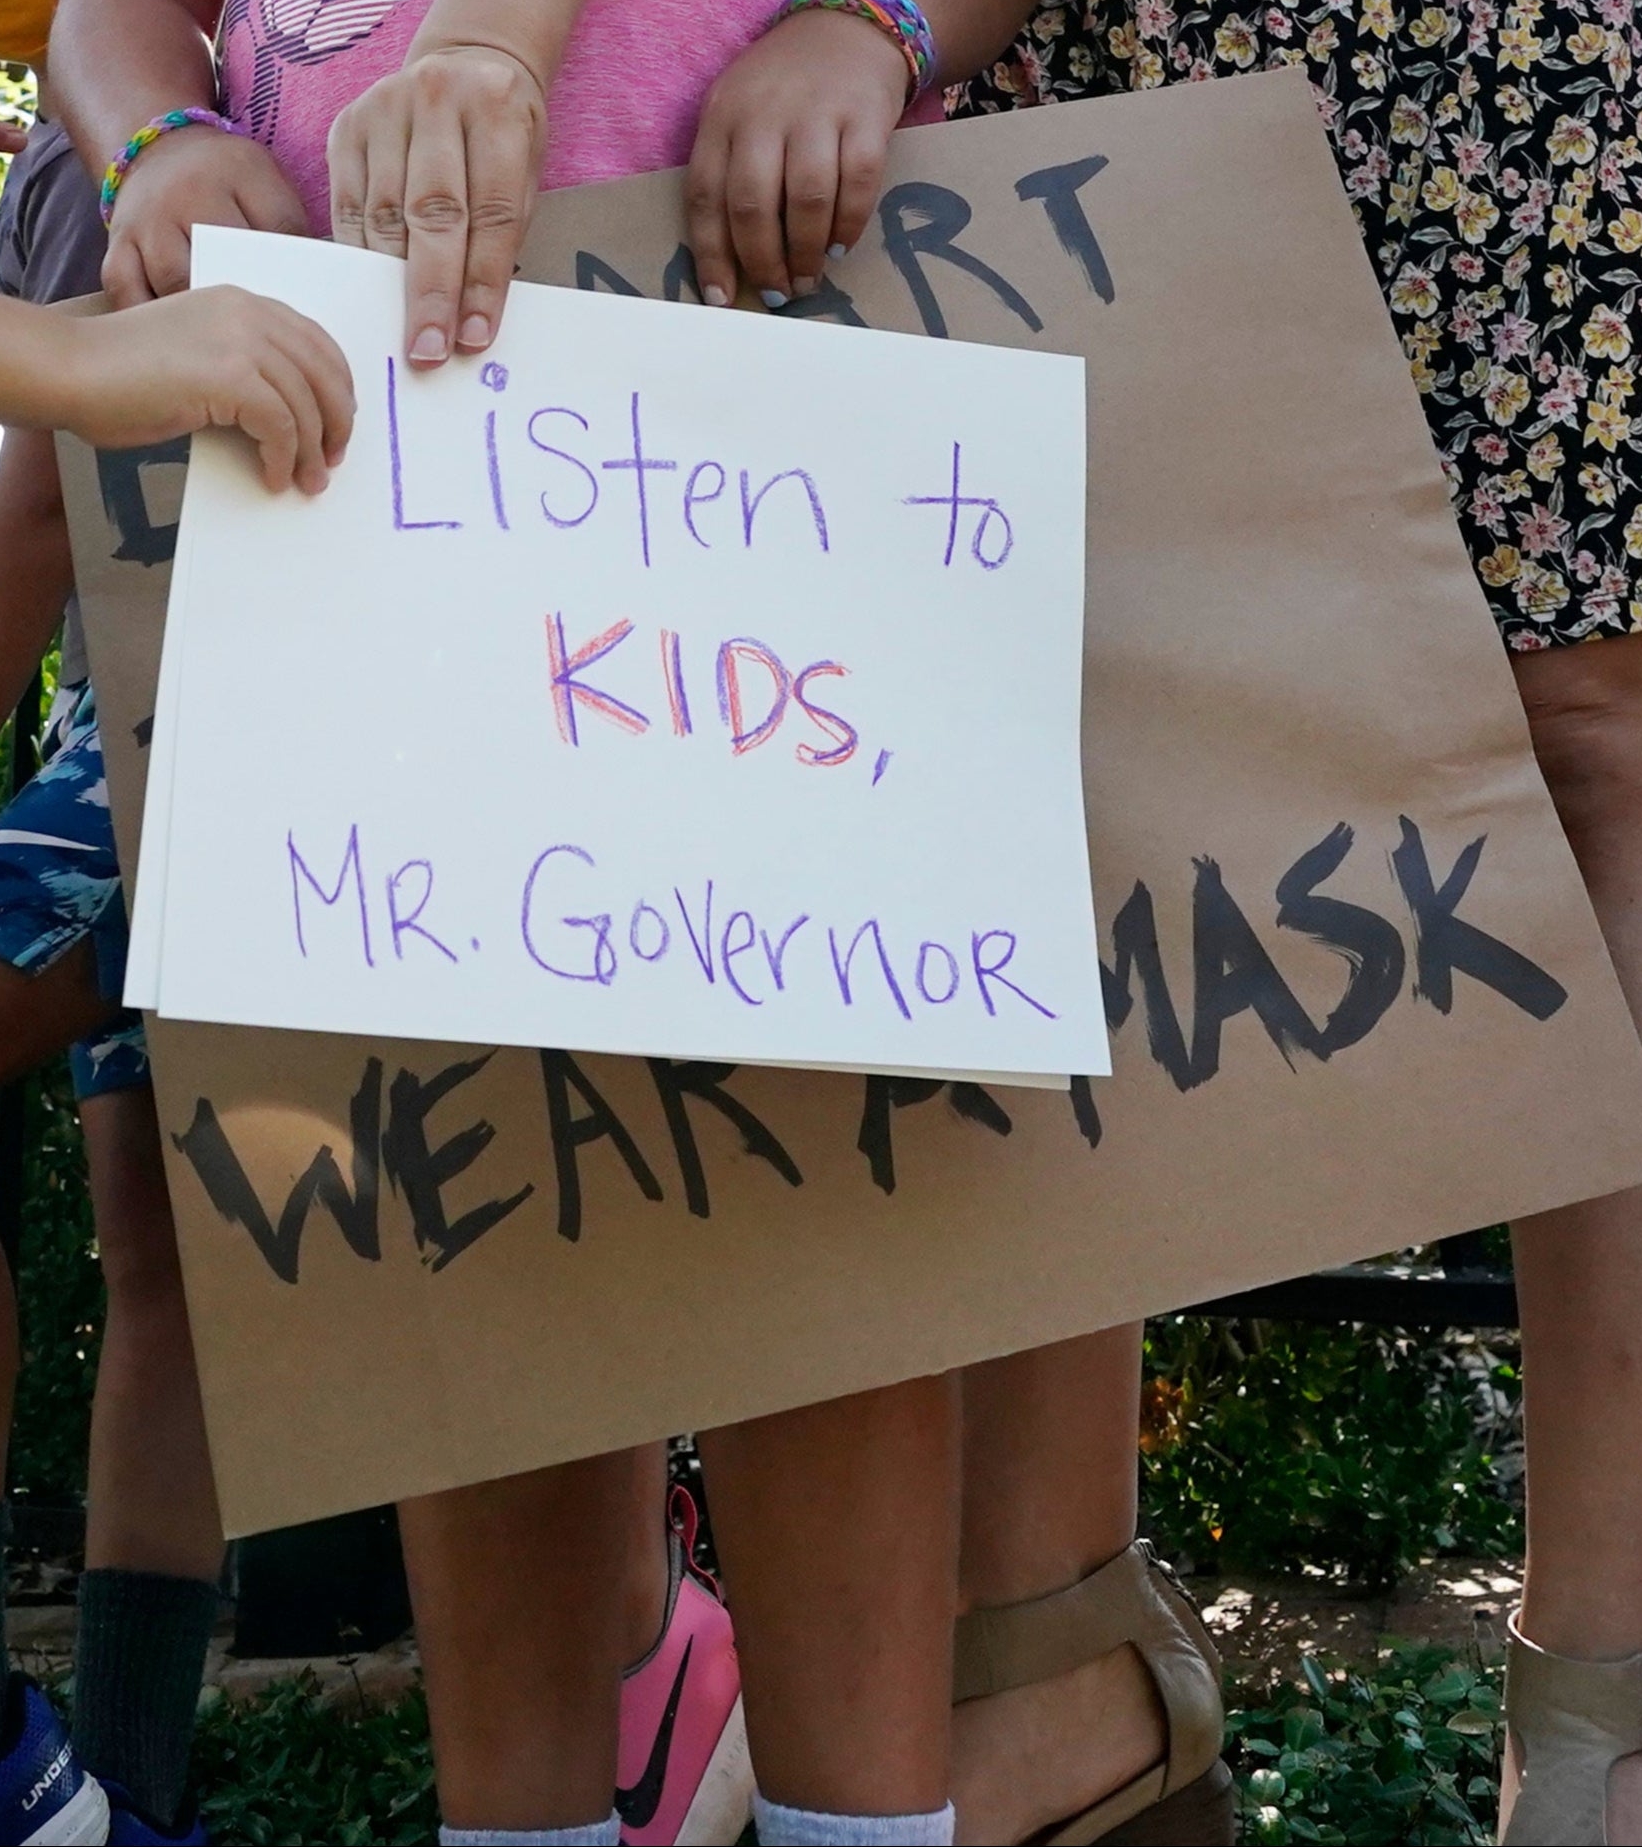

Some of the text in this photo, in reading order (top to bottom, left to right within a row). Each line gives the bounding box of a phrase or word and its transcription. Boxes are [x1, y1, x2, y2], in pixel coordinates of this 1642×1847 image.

[385, 357, 830, 567] Listen
[904, 441, 1014, 570] to
[545, 610, 892, 787] KIDS,
[172, 1048, 804, 1284] WEAR
[1069, 813, 1570, 1148] MASK
